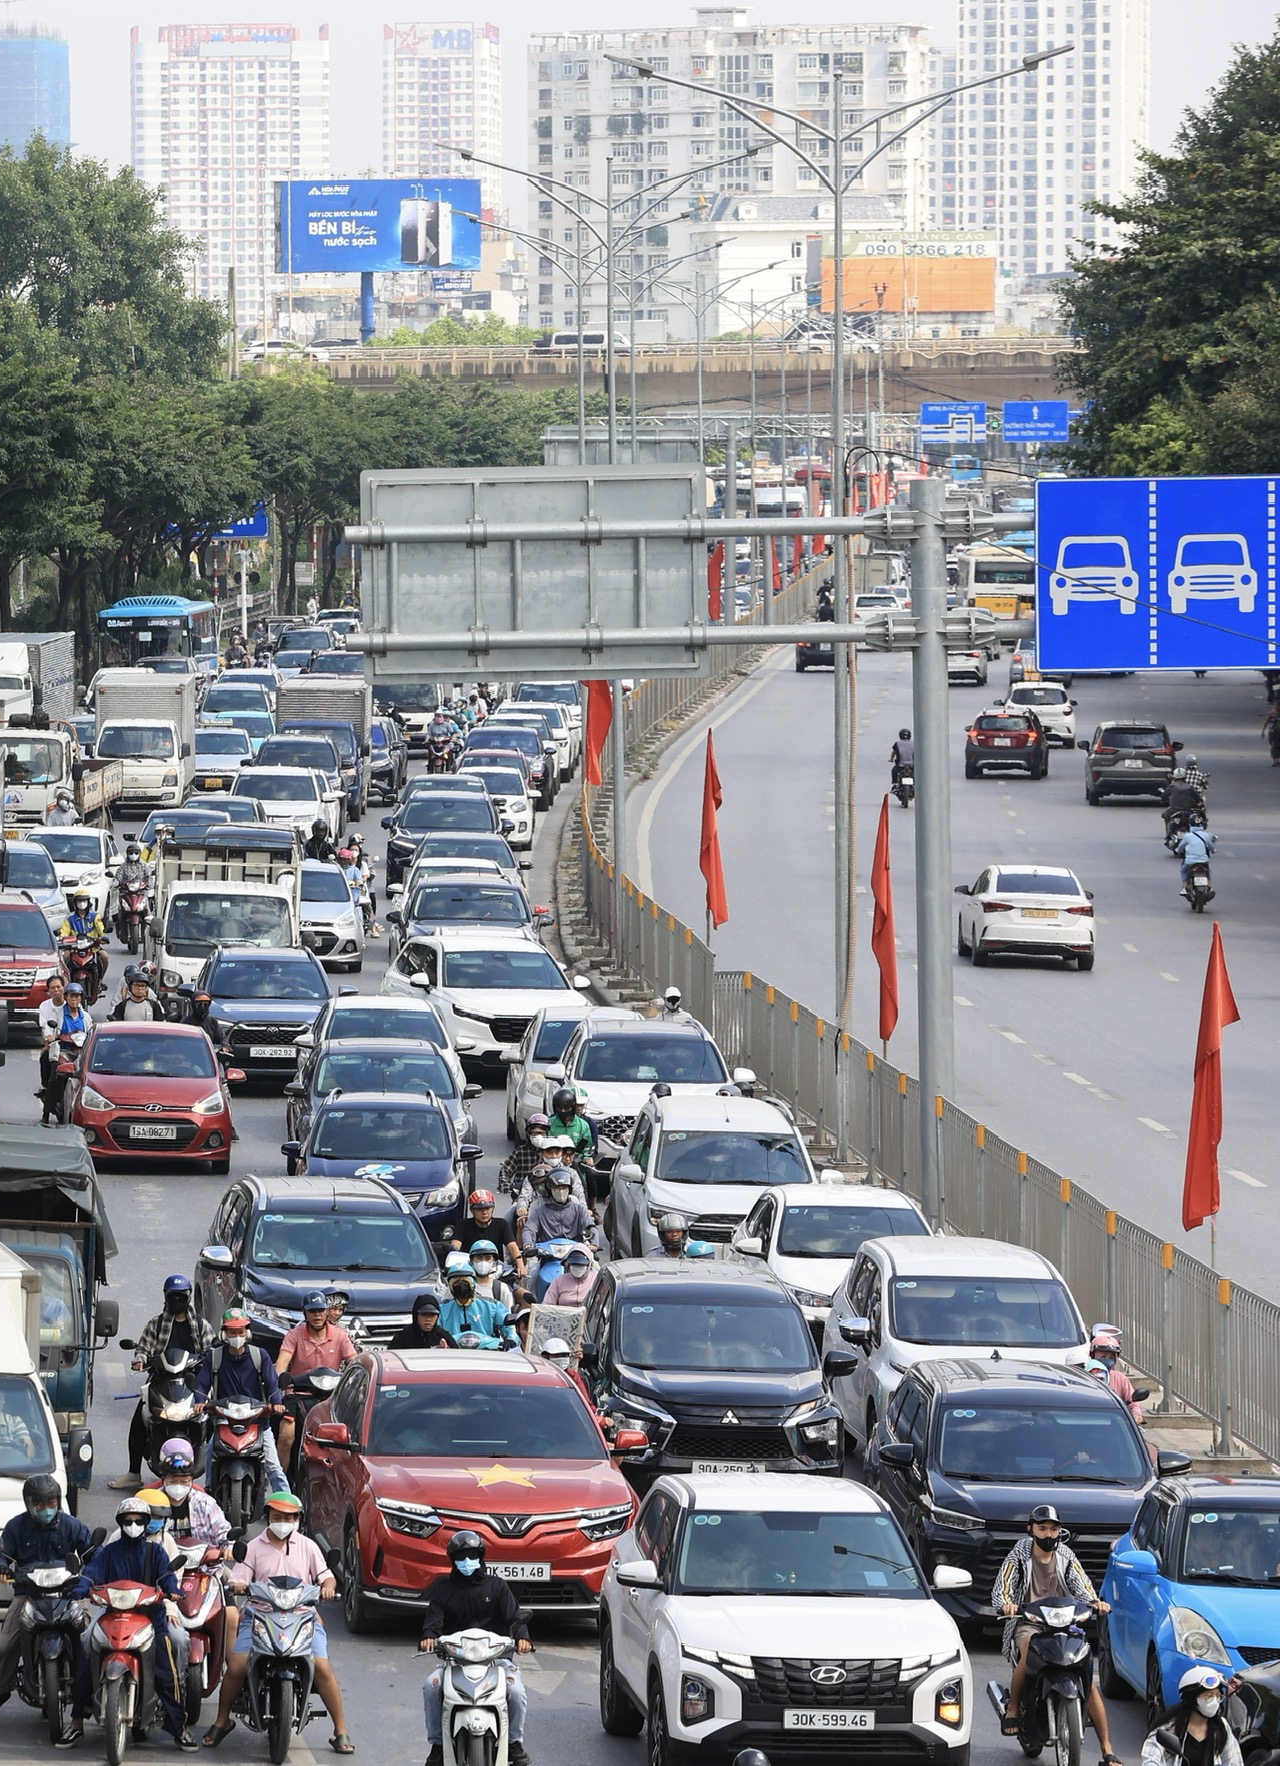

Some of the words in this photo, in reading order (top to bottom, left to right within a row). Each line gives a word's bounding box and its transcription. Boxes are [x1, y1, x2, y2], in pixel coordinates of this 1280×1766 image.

[431, 29, 473, 50] MB
[323, 236, 350, 247] nước
[351, 235, 377, 248] sạch
[865, 244, 897, 255] 090
[905, 244, 947, 255] 3366
[954, 244, 985, 255] 218
[485, 1566, 544, 1578] 0K-561.48
[792, 1713, 867, 1727] 30K-599.46
